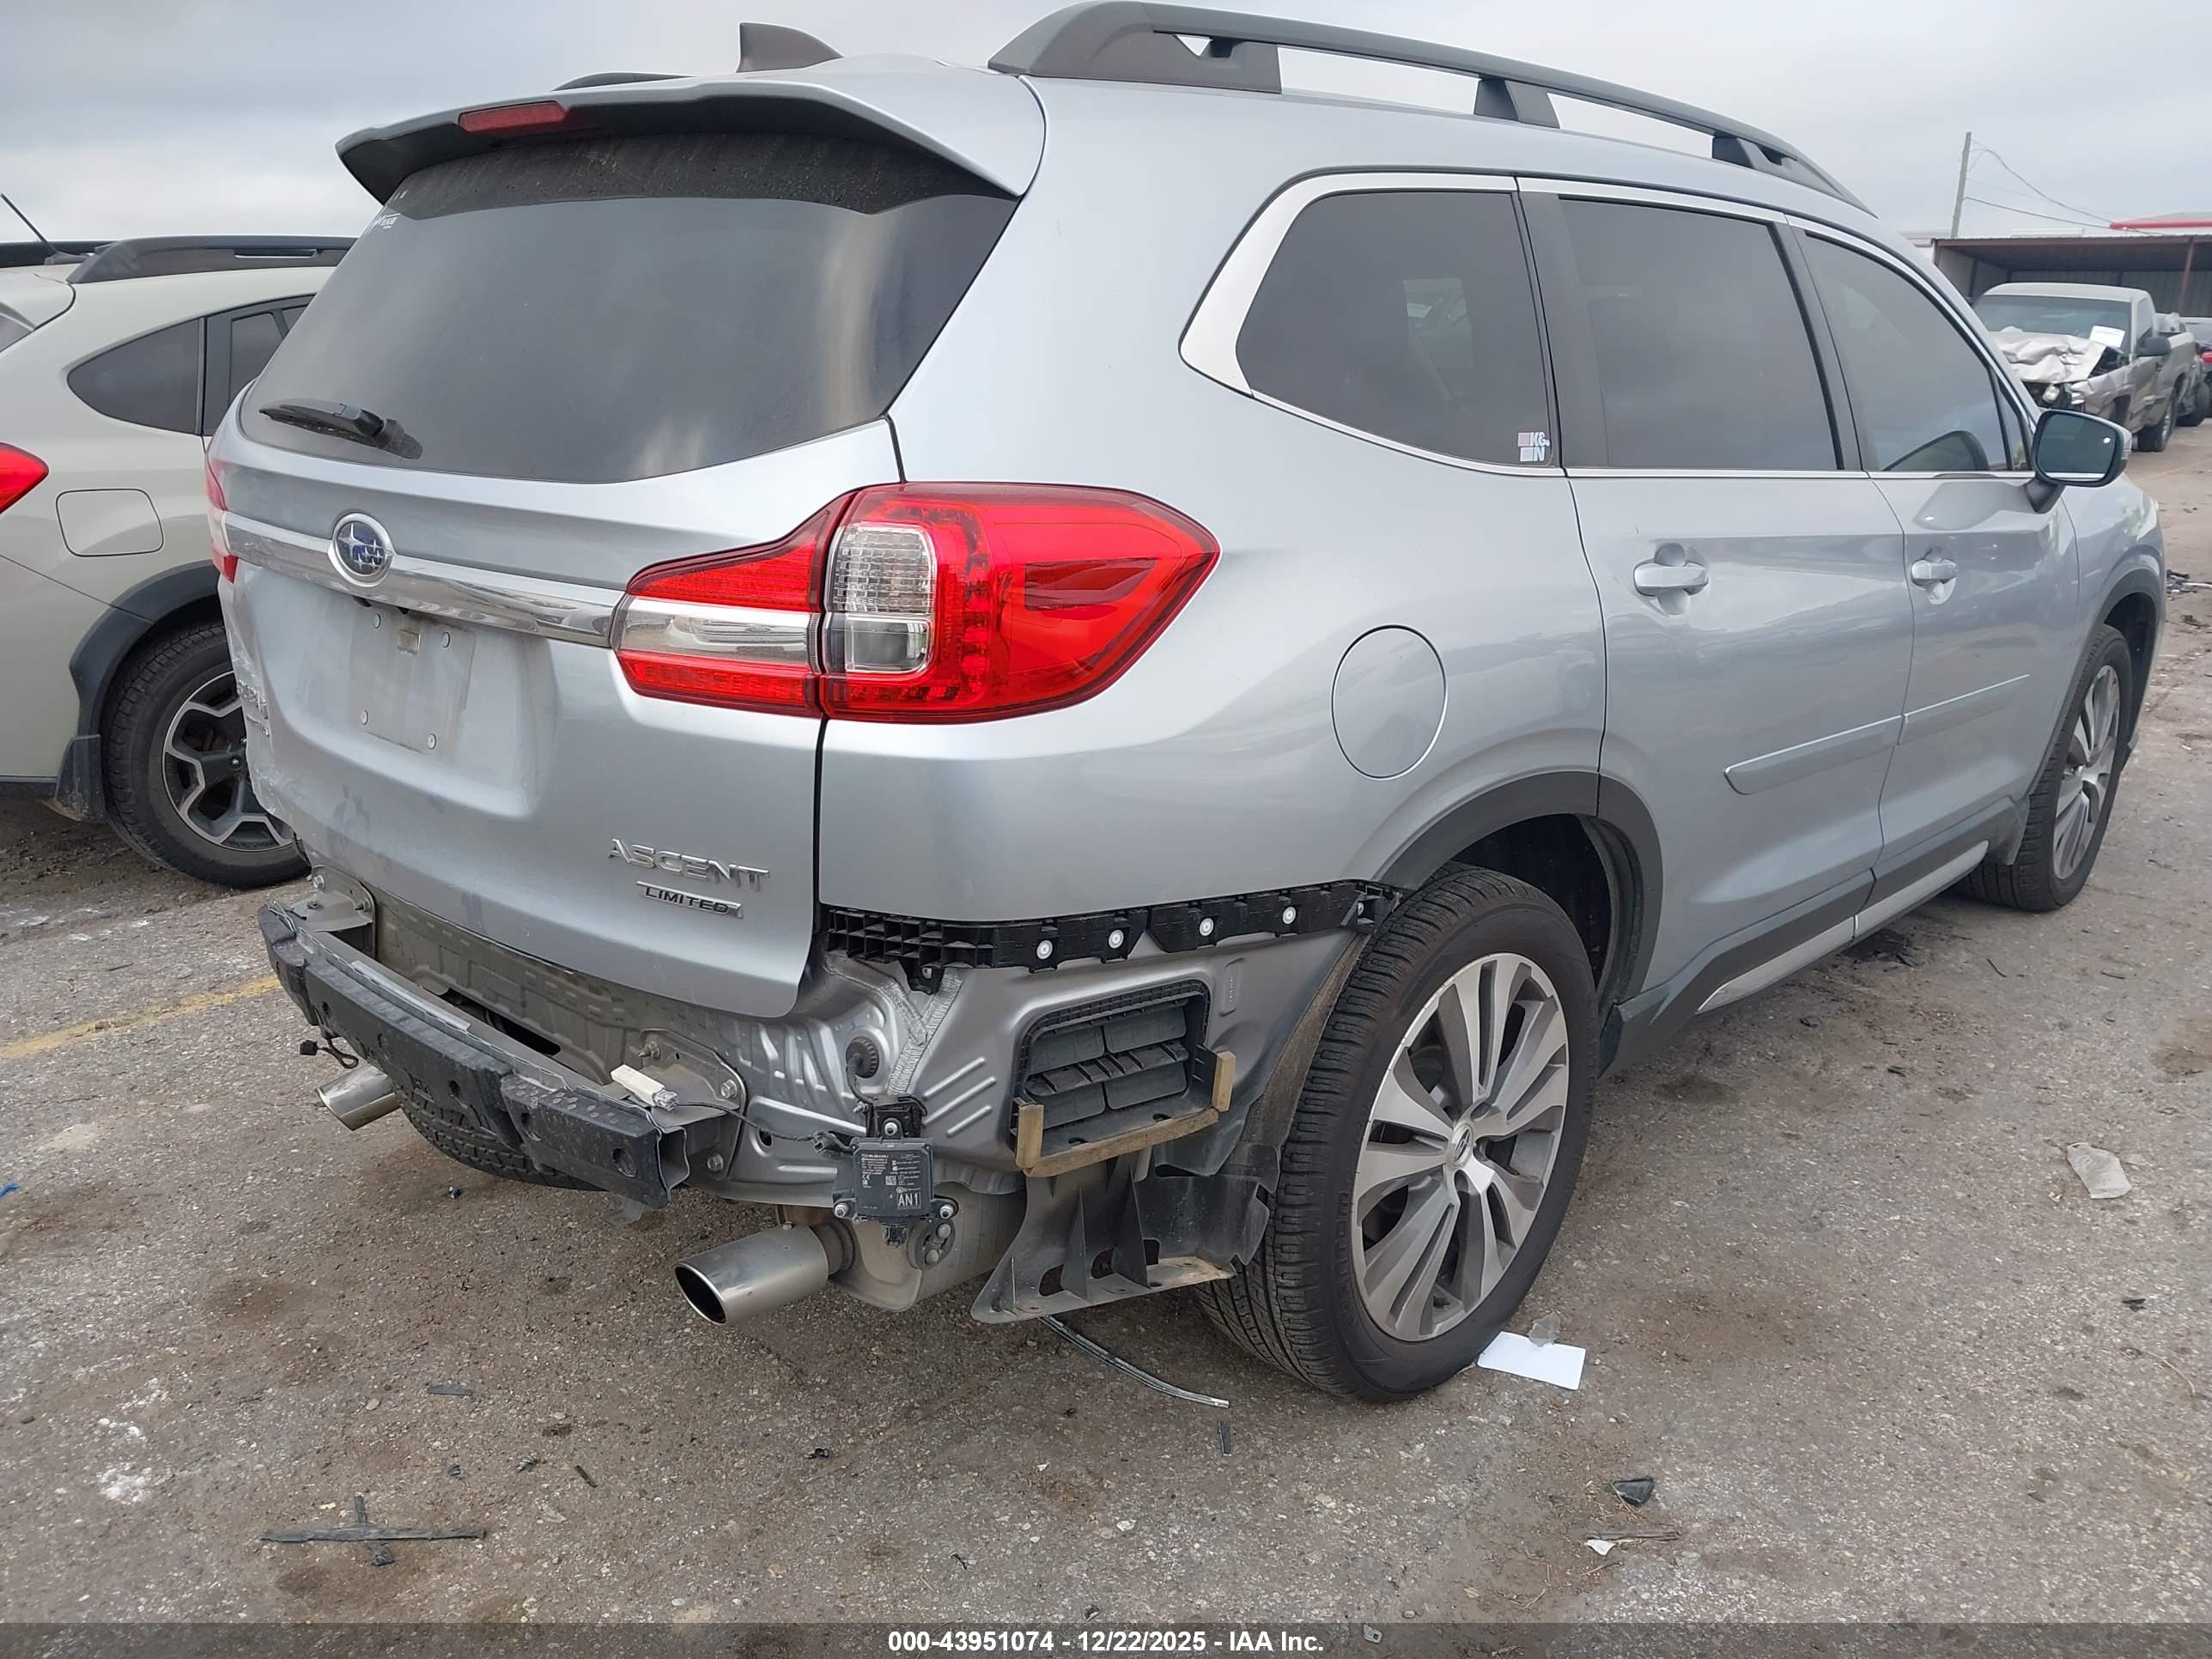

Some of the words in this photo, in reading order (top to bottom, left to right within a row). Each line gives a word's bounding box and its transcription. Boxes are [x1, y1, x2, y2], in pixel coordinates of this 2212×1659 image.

[608, 838, 770, 891] ASCENT
[645, 885, 730, 914] LIMITED
[898, 1193, 919, 1206] AN1
